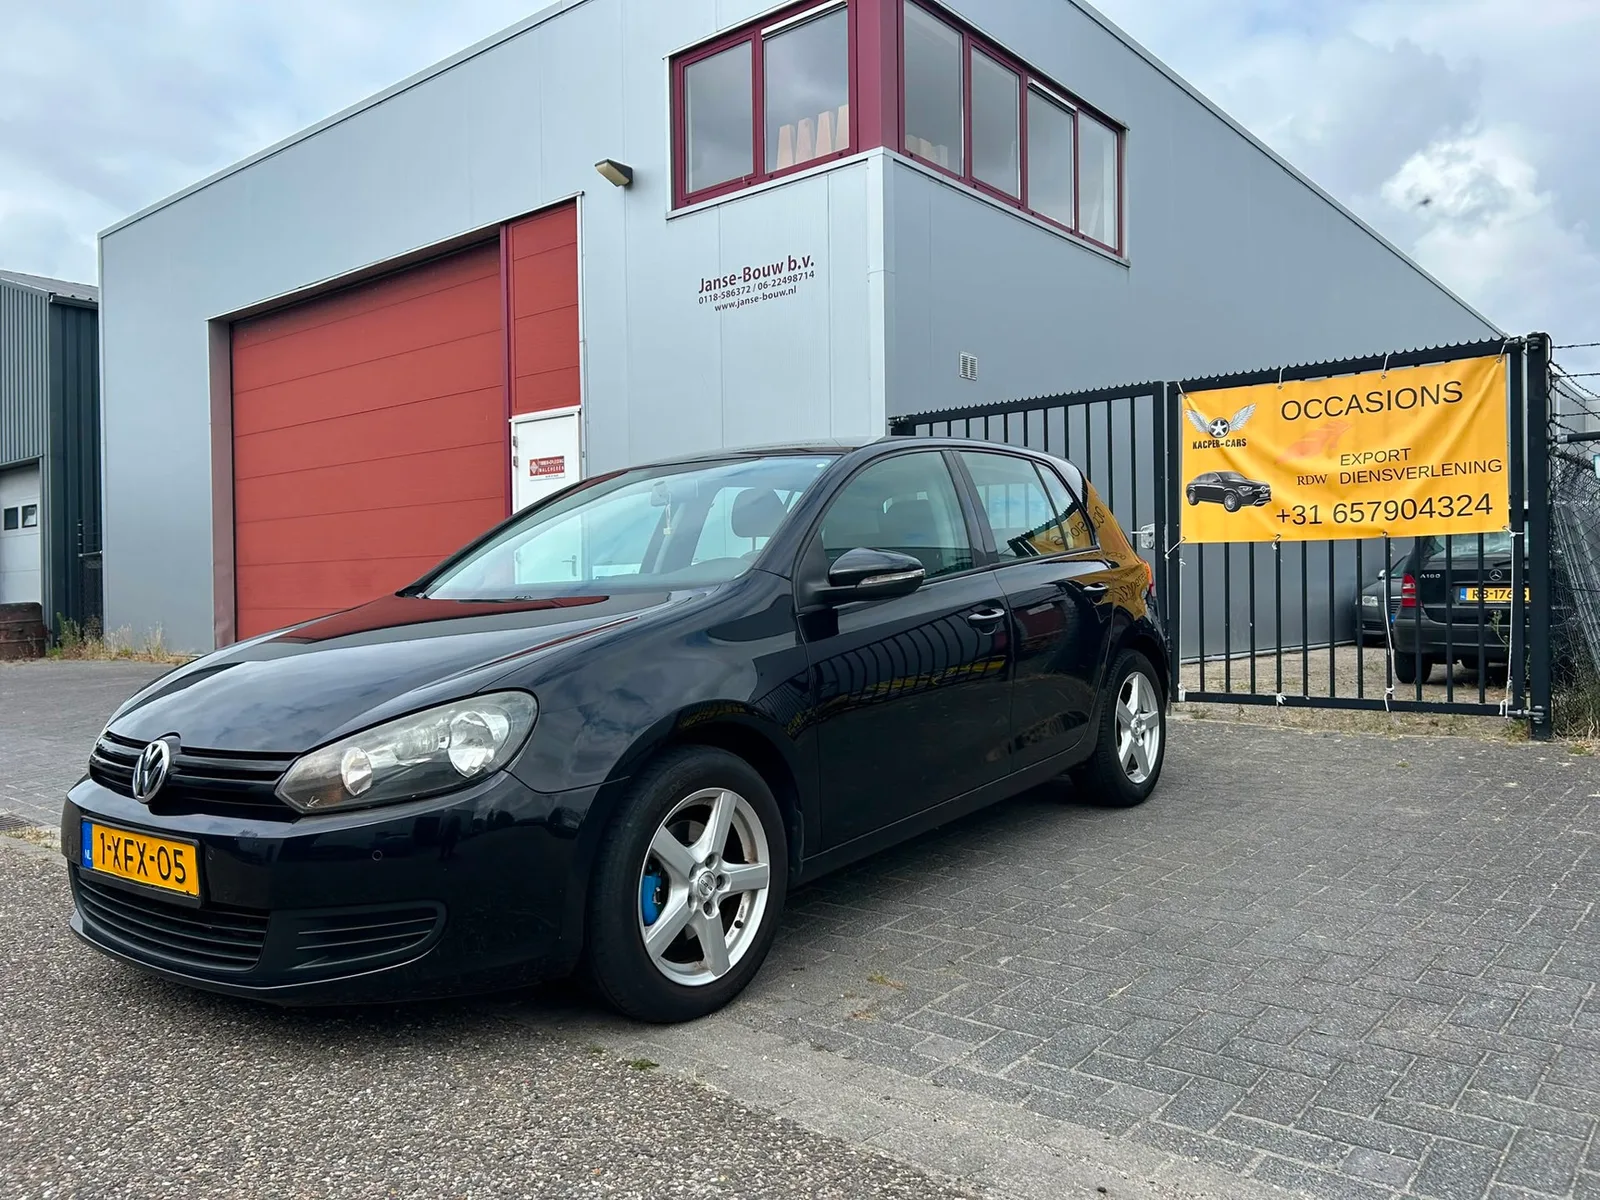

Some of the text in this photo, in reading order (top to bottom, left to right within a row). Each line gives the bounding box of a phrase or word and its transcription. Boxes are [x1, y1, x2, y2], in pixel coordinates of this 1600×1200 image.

[698, 255, 815, 294] Janse-Bouw b.v.
[698, 285, 751, 304] 0118-586372
[757, 270, 815, 290] 06-22498714
[714, 285, 797, 312] www.janse-bouw.nl
[1281, 381, 1463, 421] OCCASIONS
[1192, 438, 1247, 450] KACPER-CARS
[1340, 448, 1412, 466] EXPORT
[1297, 459, 1503, 486] RDW DIENSVERLENING
[1276, 493, 1493, 525] +31 657904324
[100, 832, 187, 884] 1-XFX-05
